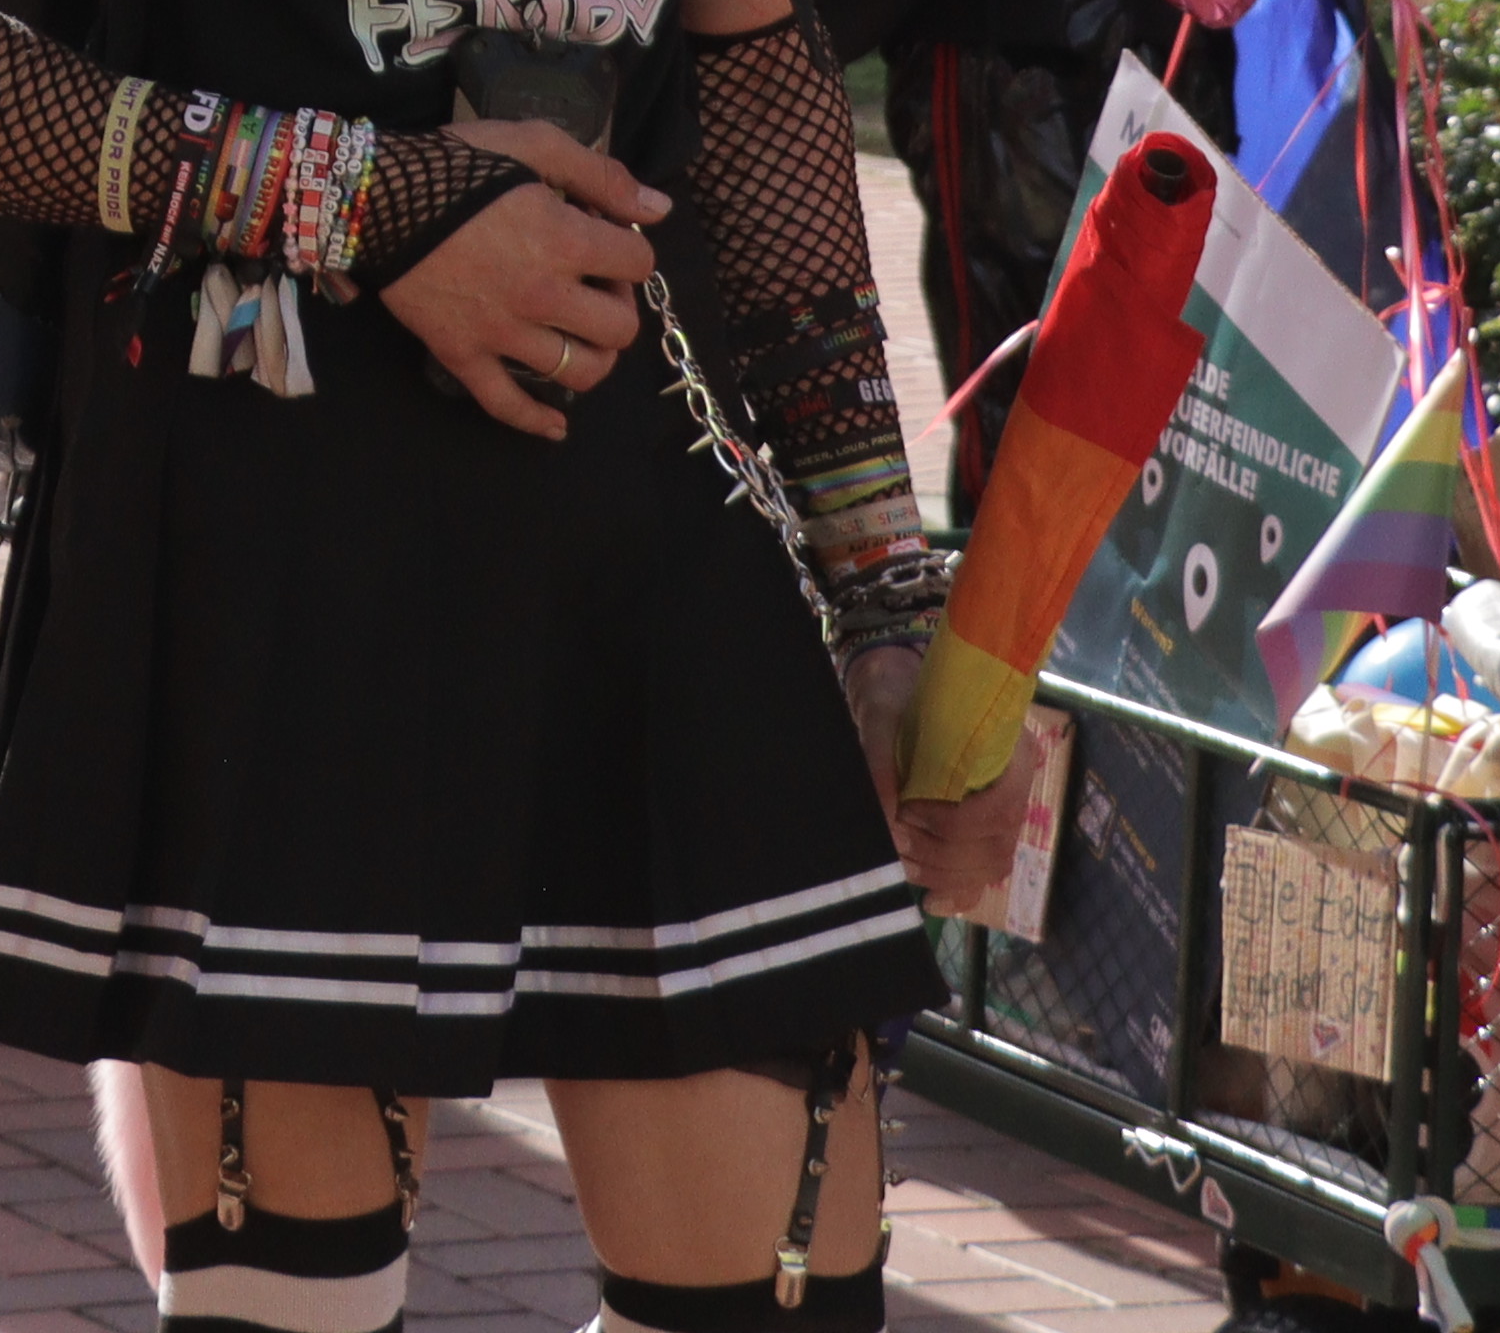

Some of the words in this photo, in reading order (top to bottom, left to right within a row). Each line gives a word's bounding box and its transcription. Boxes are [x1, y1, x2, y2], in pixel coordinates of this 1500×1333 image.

[120, 77, 145, 111] GHT
[184, 89, 220, 132] FD
[109, 115, 129, 161] FOR
[106, 167, 122, 220] PRIDE
[175, 160, 192, 192] KEIN
[166, 191, 184, 225] BOCK
[147, 243, 168, 273] NAZ
[858, 377, 894, 403] GEG
[1189, 358, 1231, 401] LDE
[1159, 427, 1258, 502] VORFÄLLE!
[1168, 394, 1341, 499] UEERFEINDLICHE
